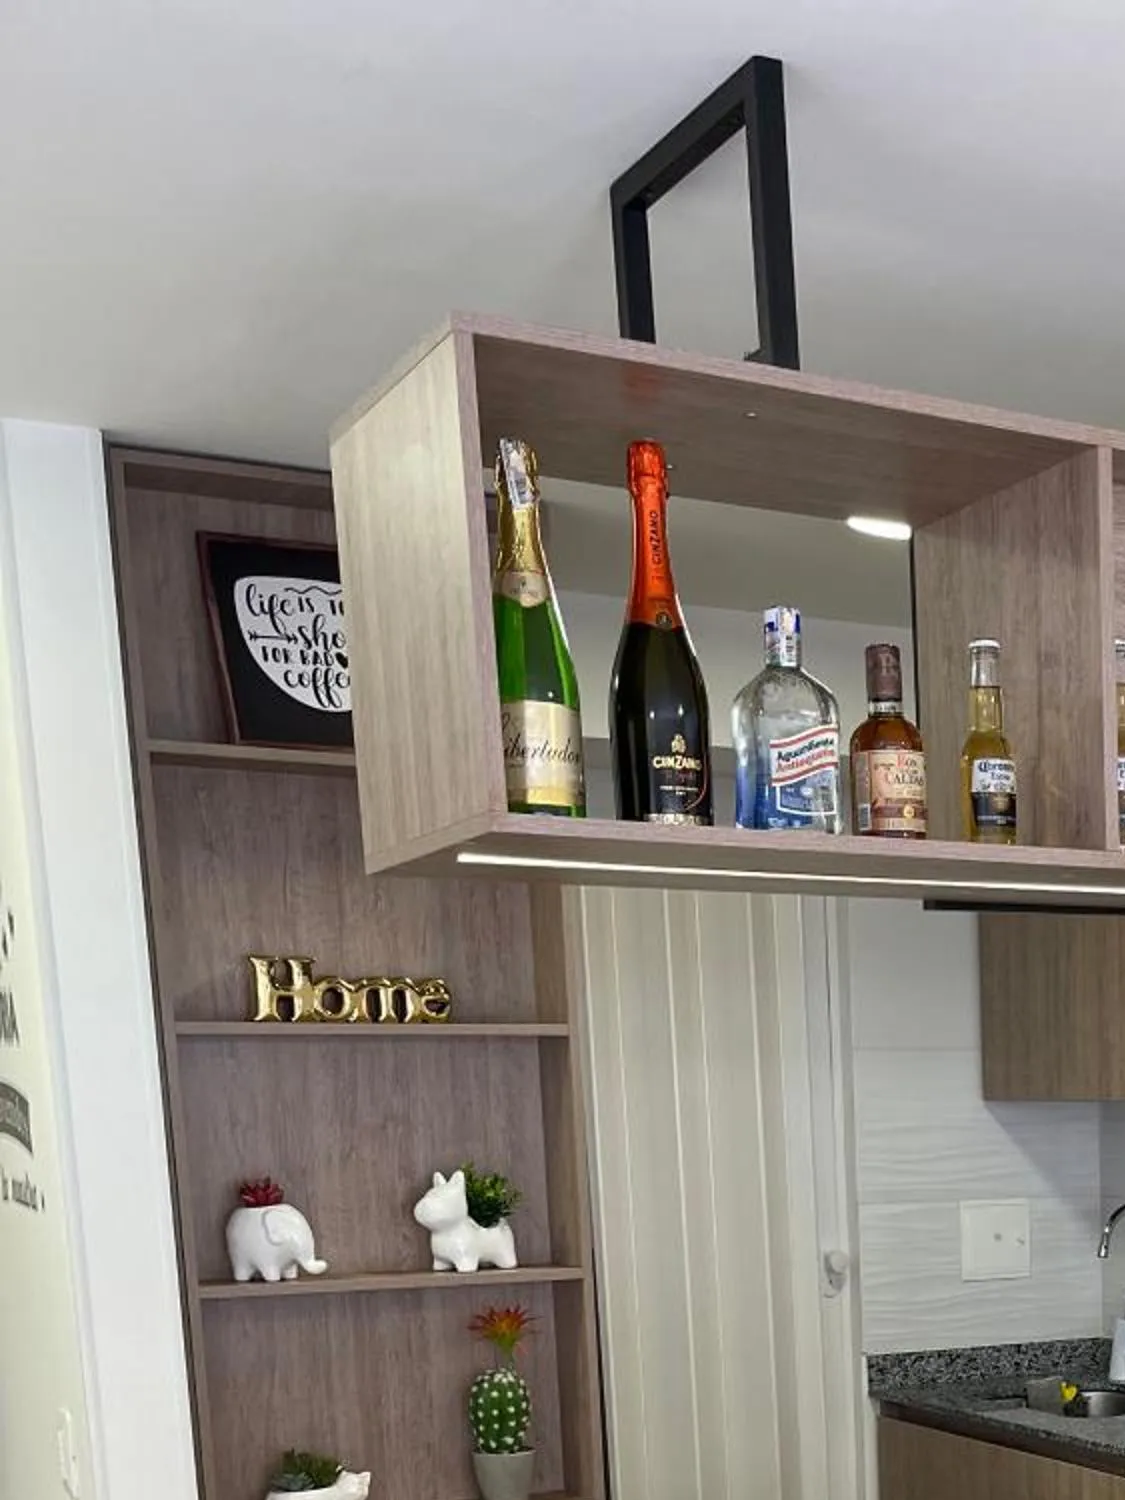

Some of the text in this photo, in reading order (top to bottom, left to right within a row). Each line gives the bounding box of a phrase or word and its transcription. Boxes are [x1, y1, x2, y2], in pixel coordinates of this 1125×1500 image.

[298, 614, 347, 651] sho
[284, 667, 351, 709] coffe
[248, 955, 452, 1024] Home
